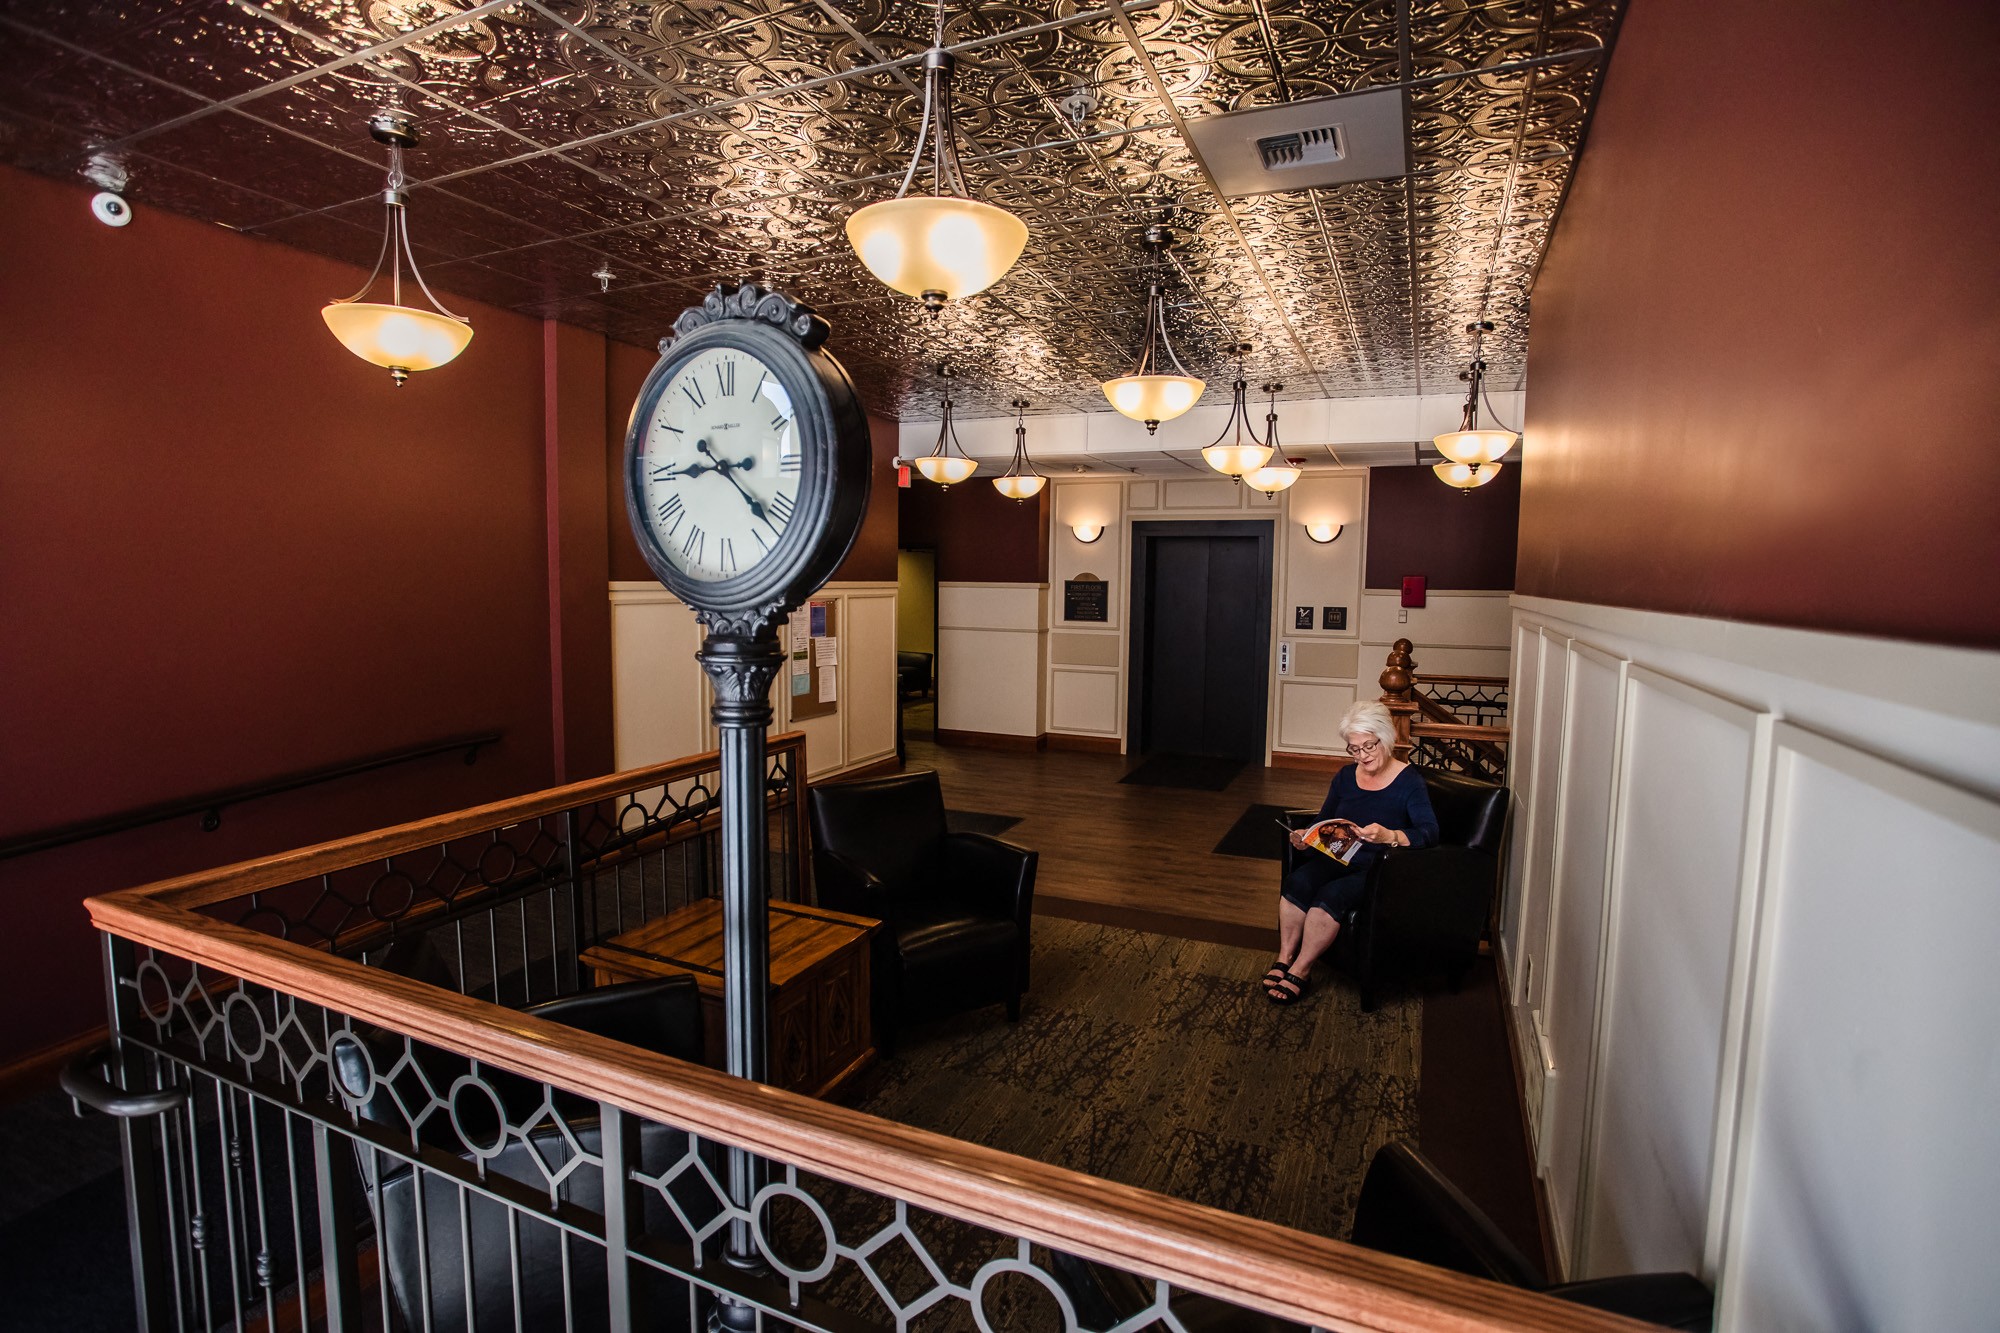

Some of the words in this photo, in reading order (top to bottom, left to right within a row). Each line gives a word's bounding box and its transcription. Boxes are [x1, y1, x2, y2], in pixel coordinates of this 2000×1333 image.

[682, 377, 707, 415] XI
[715, 361, 735, 399] XII
[660, 416, 684, 442] X
[657, 492, 686, 537] VIII
[682, 524, 705, 565] VII
[720, 537, 737, 572] VI
